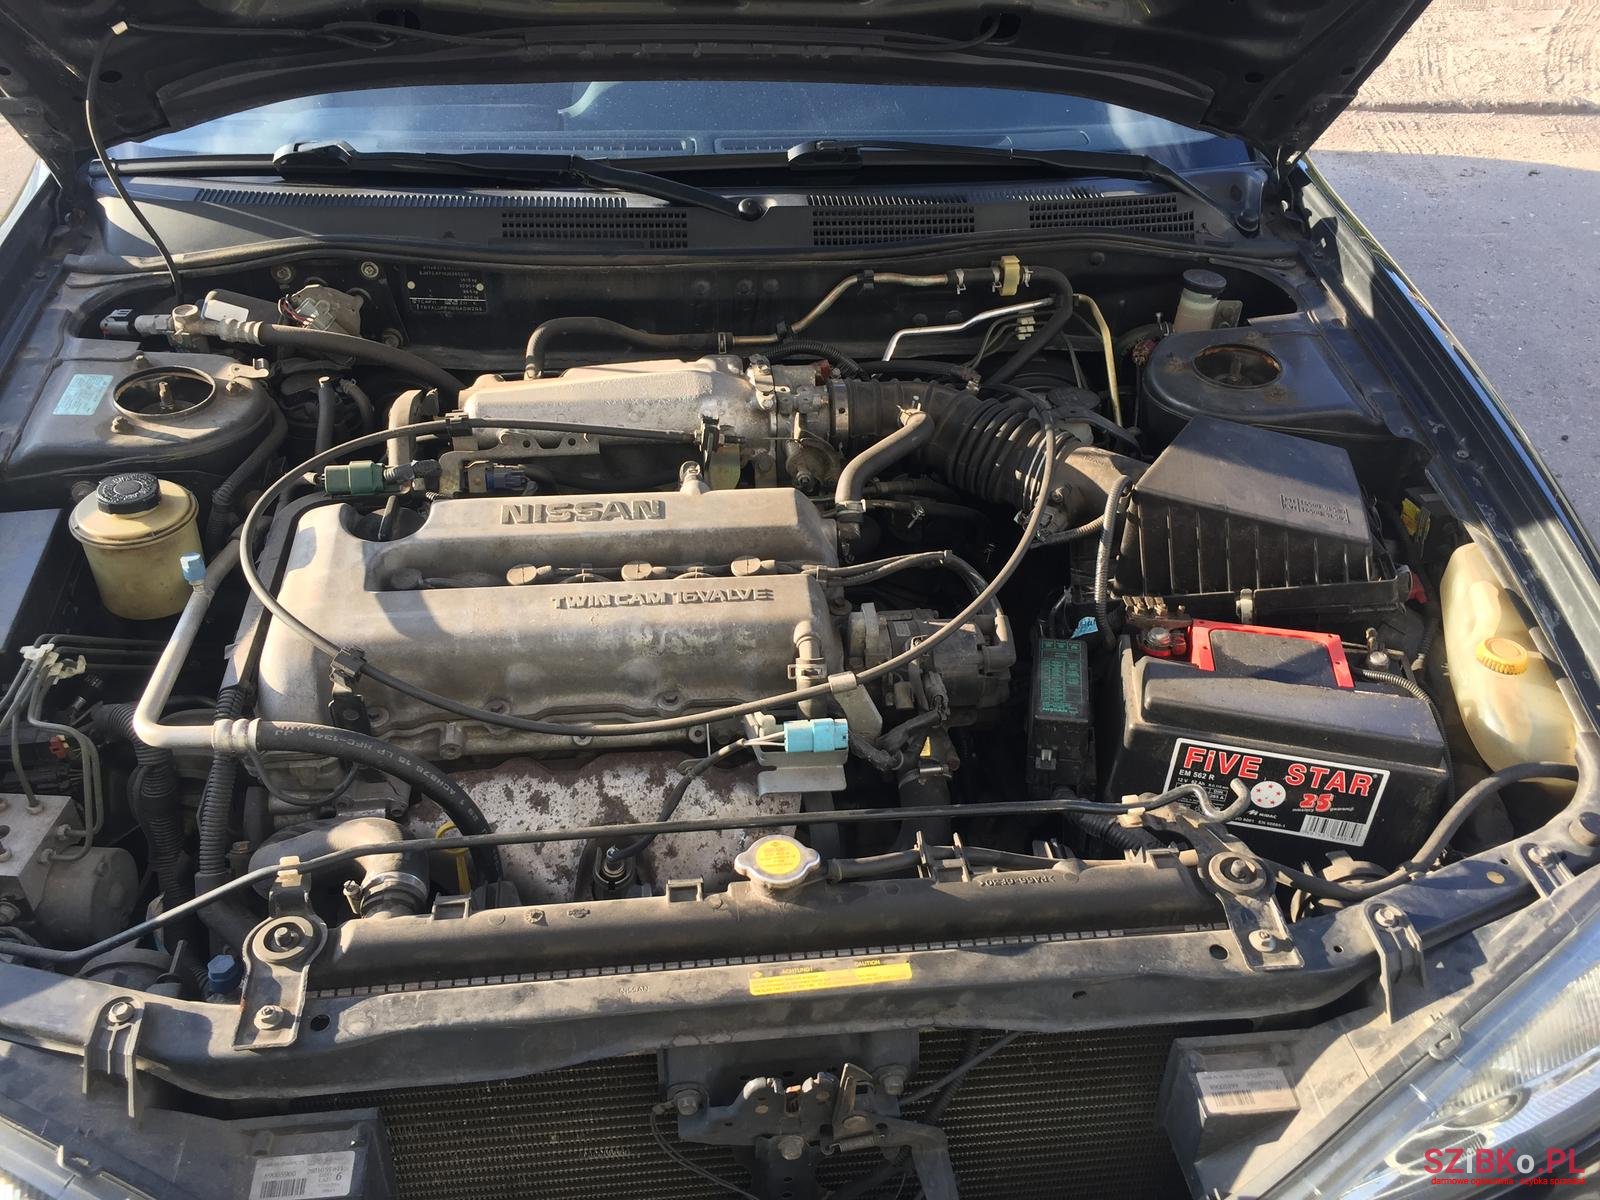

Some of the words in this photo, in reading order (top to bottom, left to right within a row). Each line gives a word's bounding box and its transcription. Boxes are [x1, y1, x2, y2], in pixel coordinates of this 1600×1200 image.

[501, 500, 667, 525] NISSAN
[552, 593, 611, 610] TWIN
[612, 591, 671, 606] CAM
[1179, 769, 1192, 777] EM
[1193, 772, 1206, 780] 562
[1285, 763, 1374, 796] STAR
[1299, 793, 1334, 812] 25
